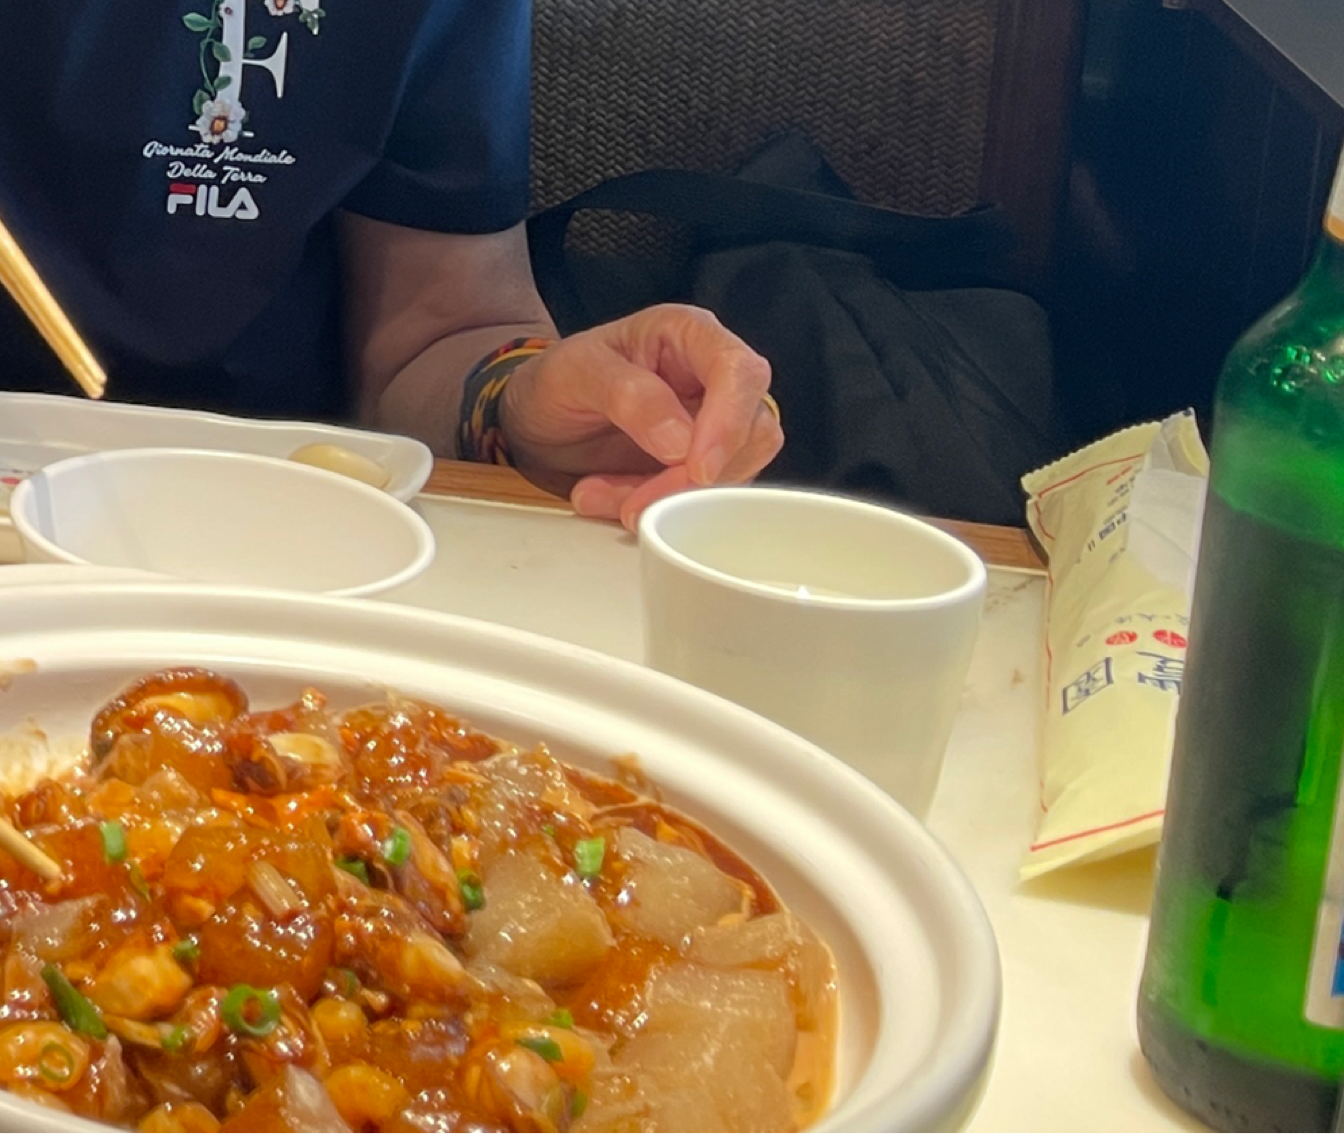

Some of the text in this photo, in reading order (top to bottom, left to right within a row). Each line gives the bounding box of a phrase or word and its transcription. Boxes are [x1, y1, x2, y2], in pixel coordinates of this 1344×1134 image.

[142, 140, 296, 165] Giornata Mondiale
[166, 161, 267, 185] Della Terra
[166, 182, 260, 220] FILA
